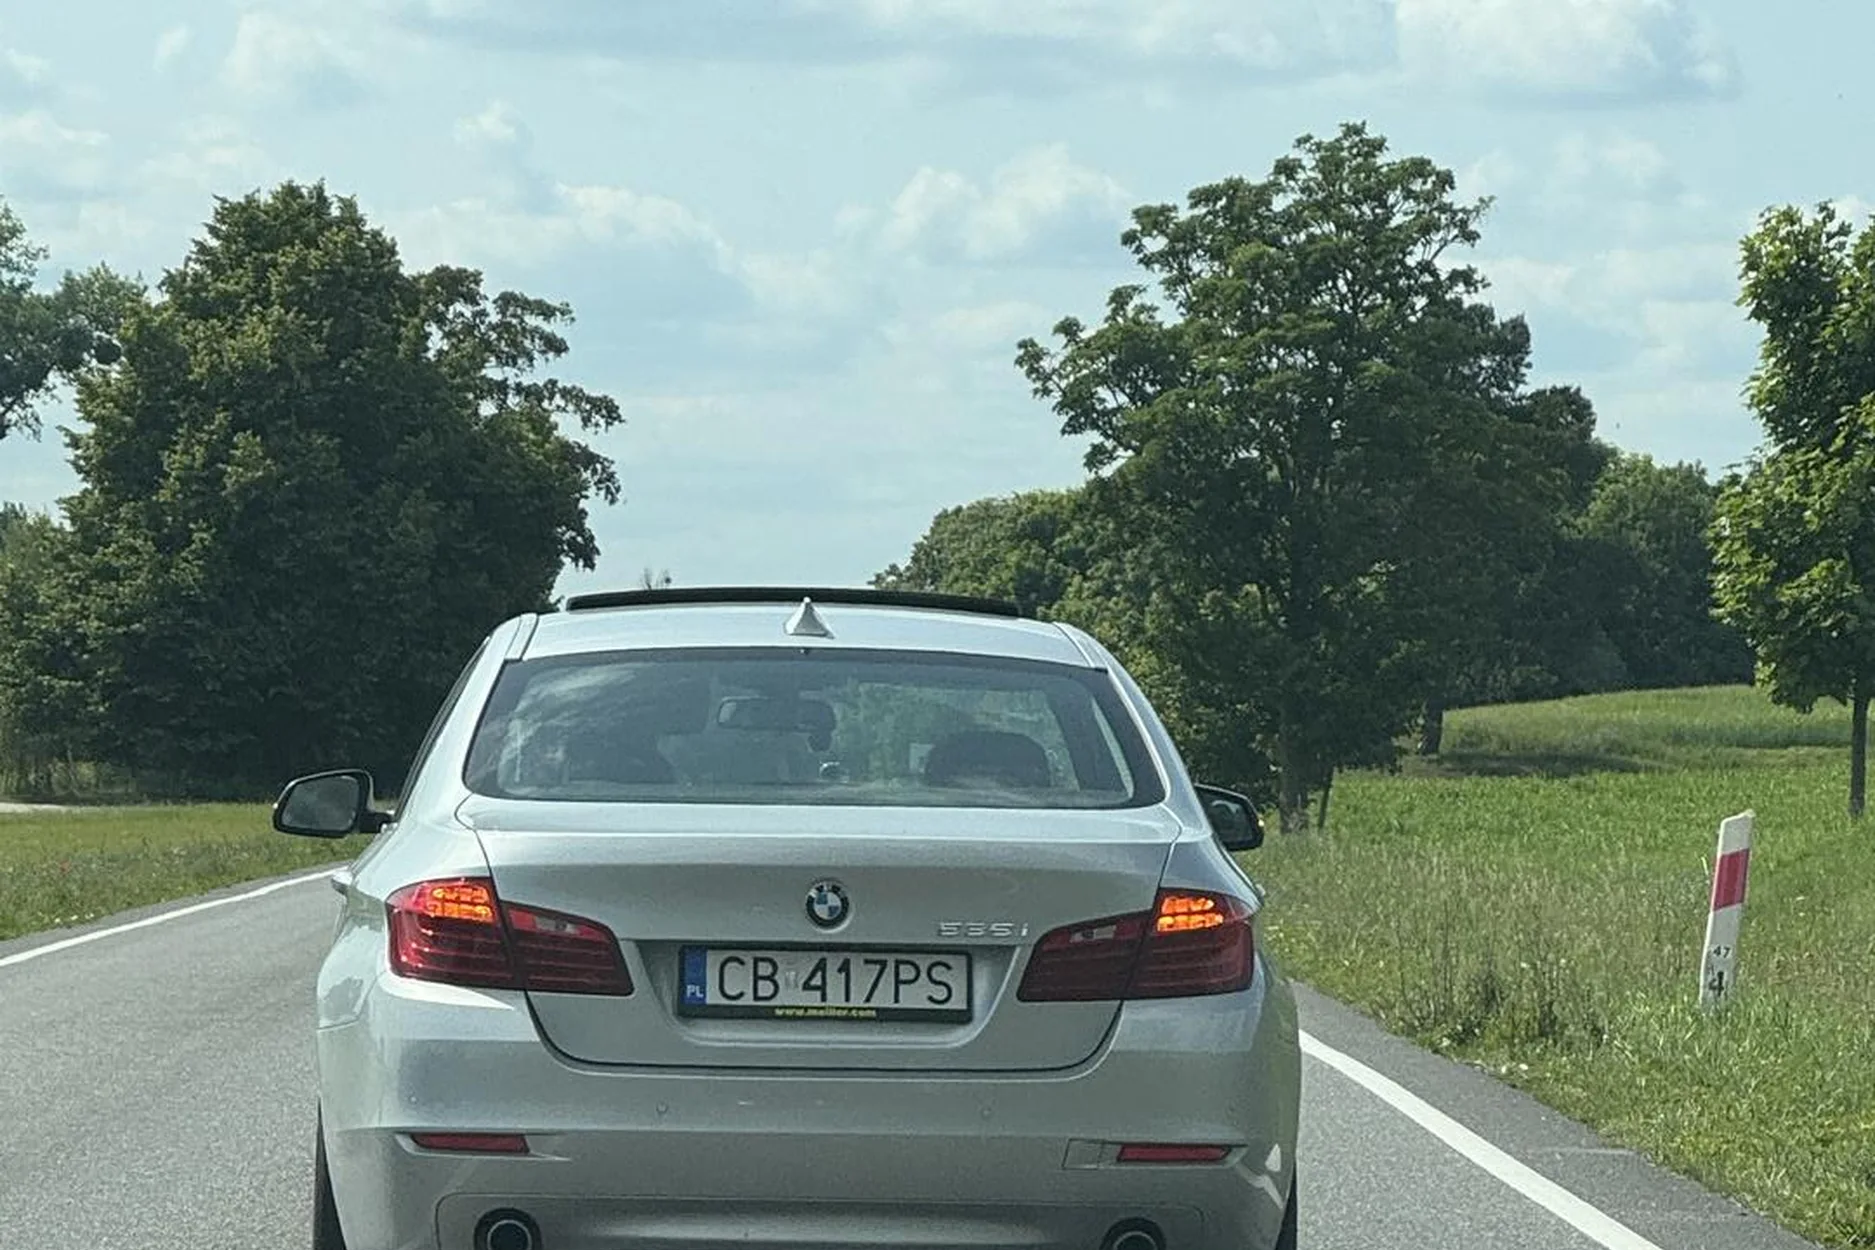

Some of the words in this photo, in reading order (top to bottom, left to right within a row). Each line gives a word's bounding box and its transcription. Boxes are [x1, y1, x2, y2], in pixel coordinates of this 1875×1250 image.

[940, 922, 1029, 937] 535i
[1713, 945, 1730, 958] 47
[718, 956, 780, 1001] CB
[801, 957, 954, 1004] 417PS
[687, 985, 704, 997] PL
